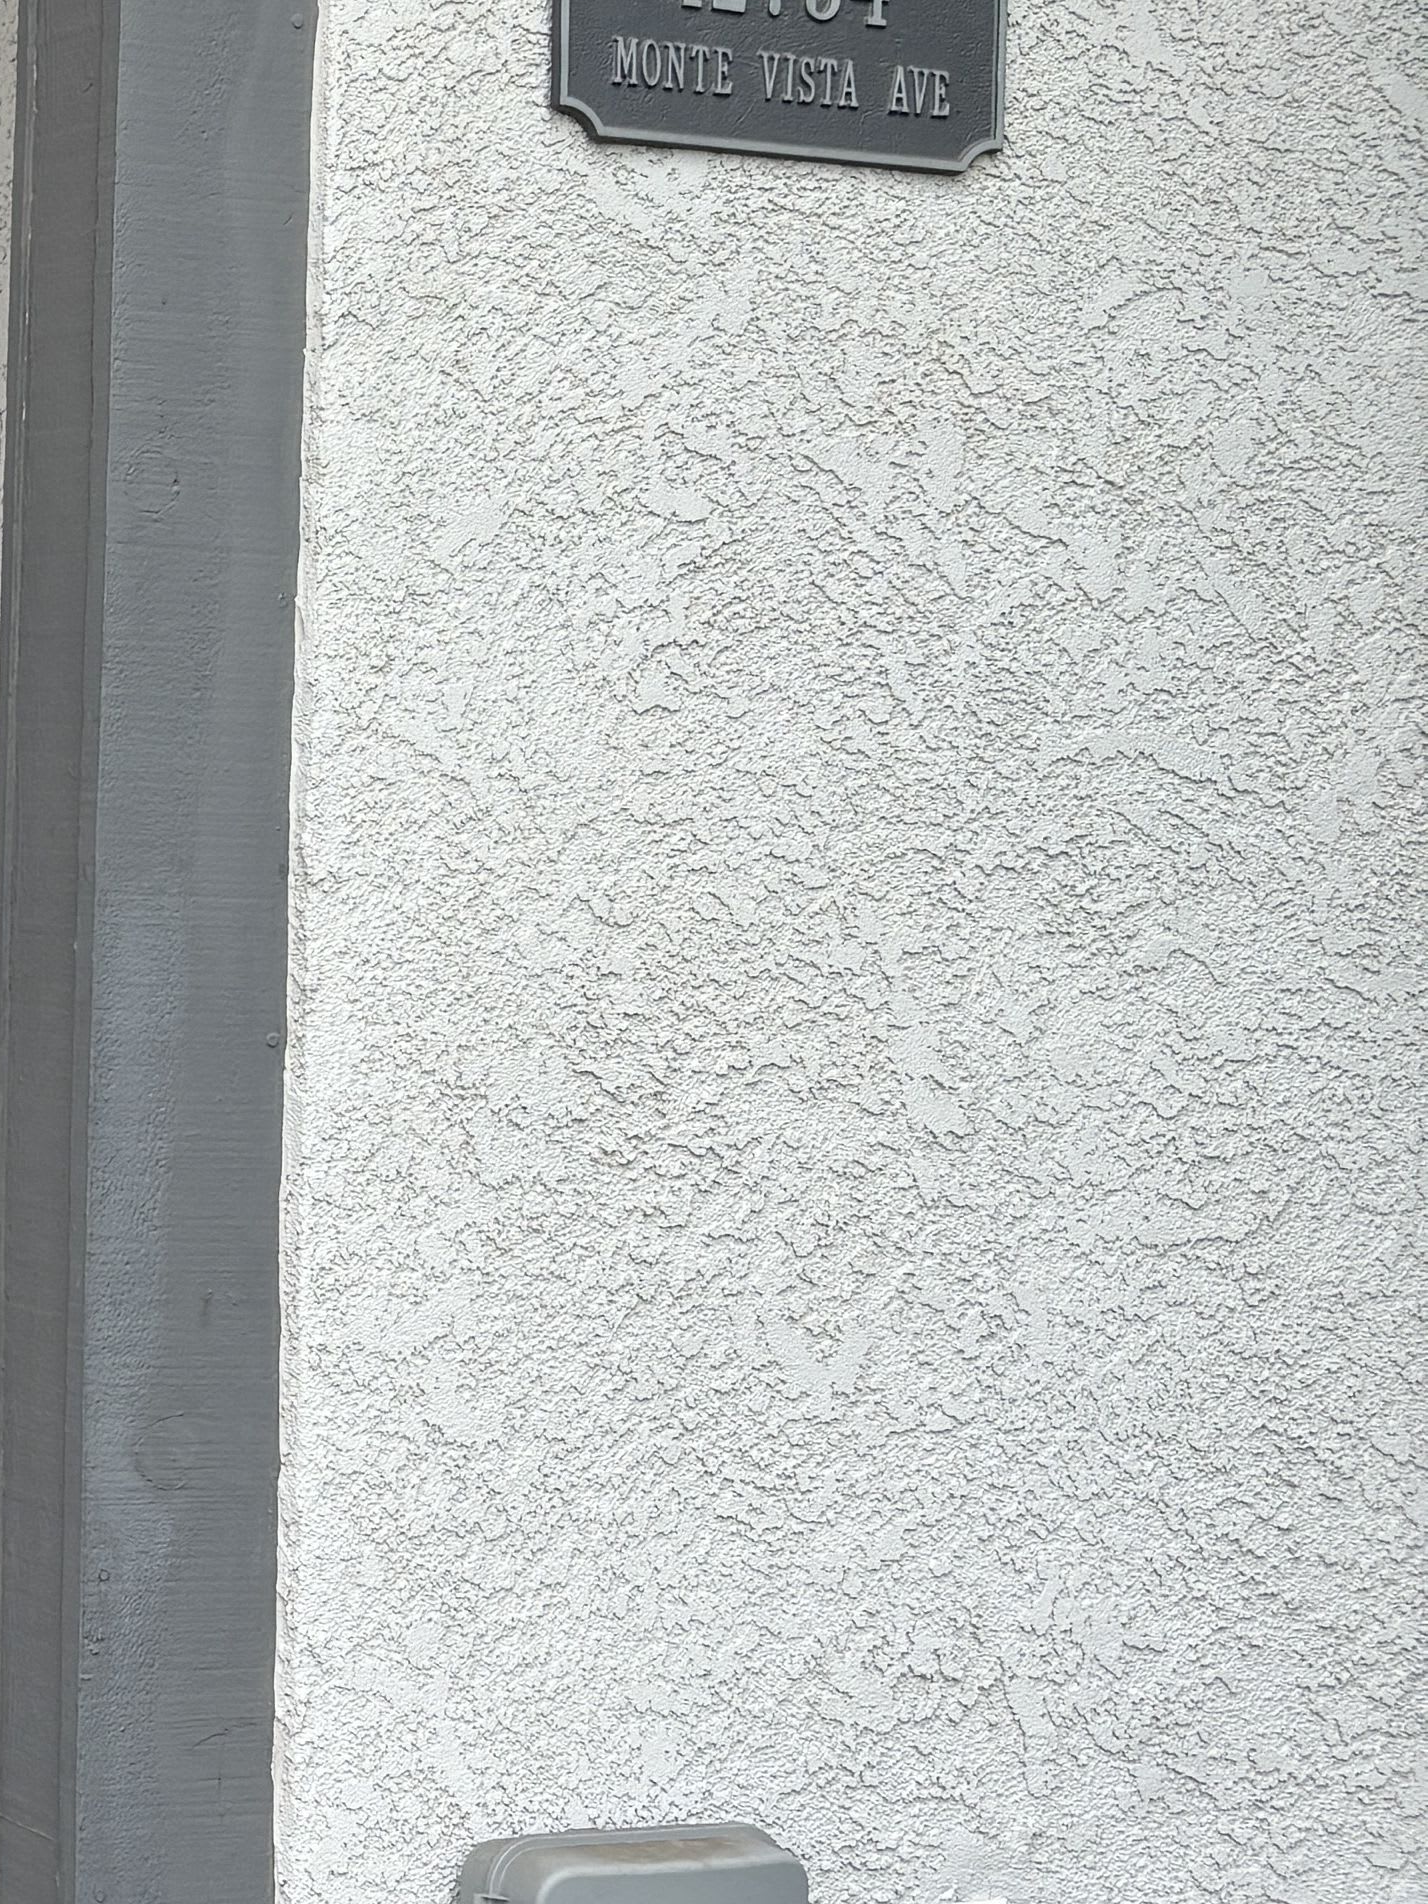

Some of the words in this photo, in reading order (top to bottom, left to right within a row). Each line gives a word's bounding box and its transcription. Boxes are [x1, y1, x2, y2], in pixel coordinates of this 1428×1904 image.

[612, 36, 733, 94] MONTE
[756, 51, 859, 108] VISTA
[886, 65, 950, 118] AVE
